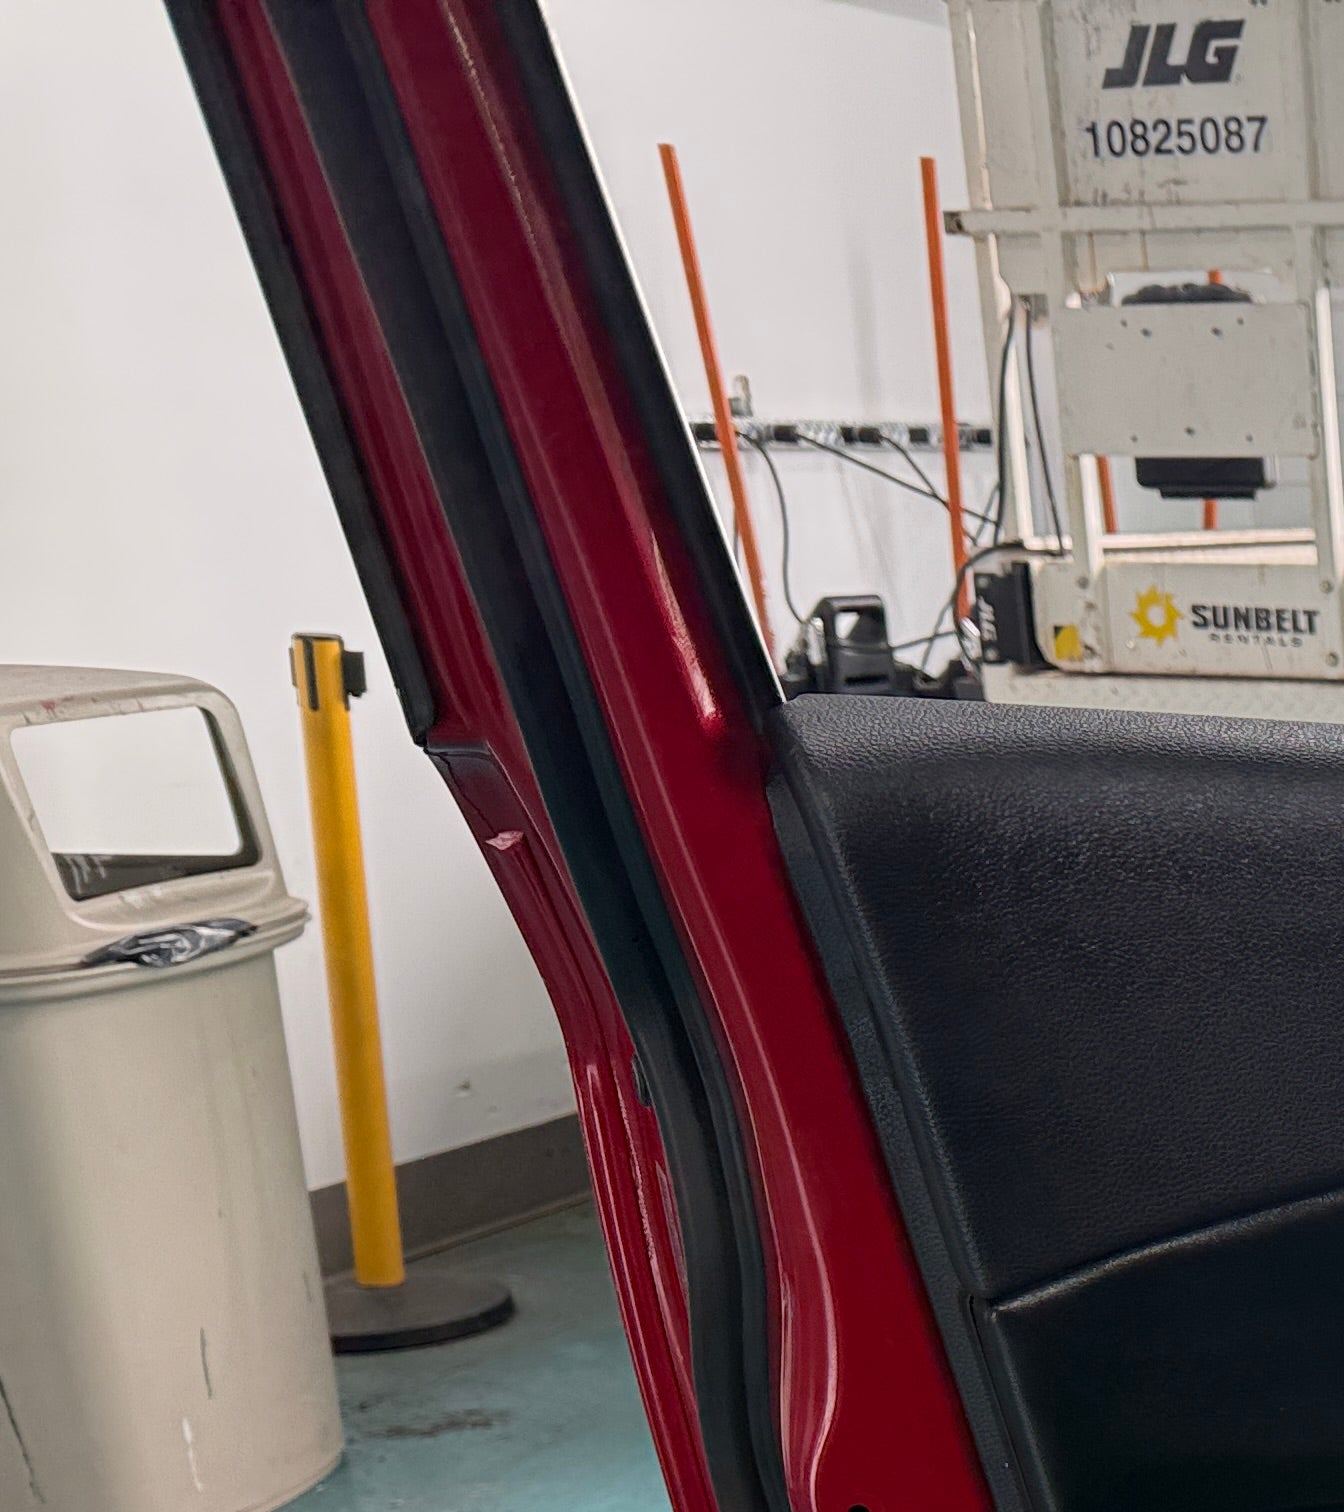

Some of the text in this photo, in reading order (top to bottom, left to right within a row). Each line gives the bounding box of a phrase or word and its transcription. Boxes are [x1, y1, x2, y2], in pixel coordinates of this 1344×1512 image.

[1102, 19, 1245, 89] JLG
[1086, 116, 1267, 157] 10825087
[1191, 605, 1320, 635] SUNBELT
